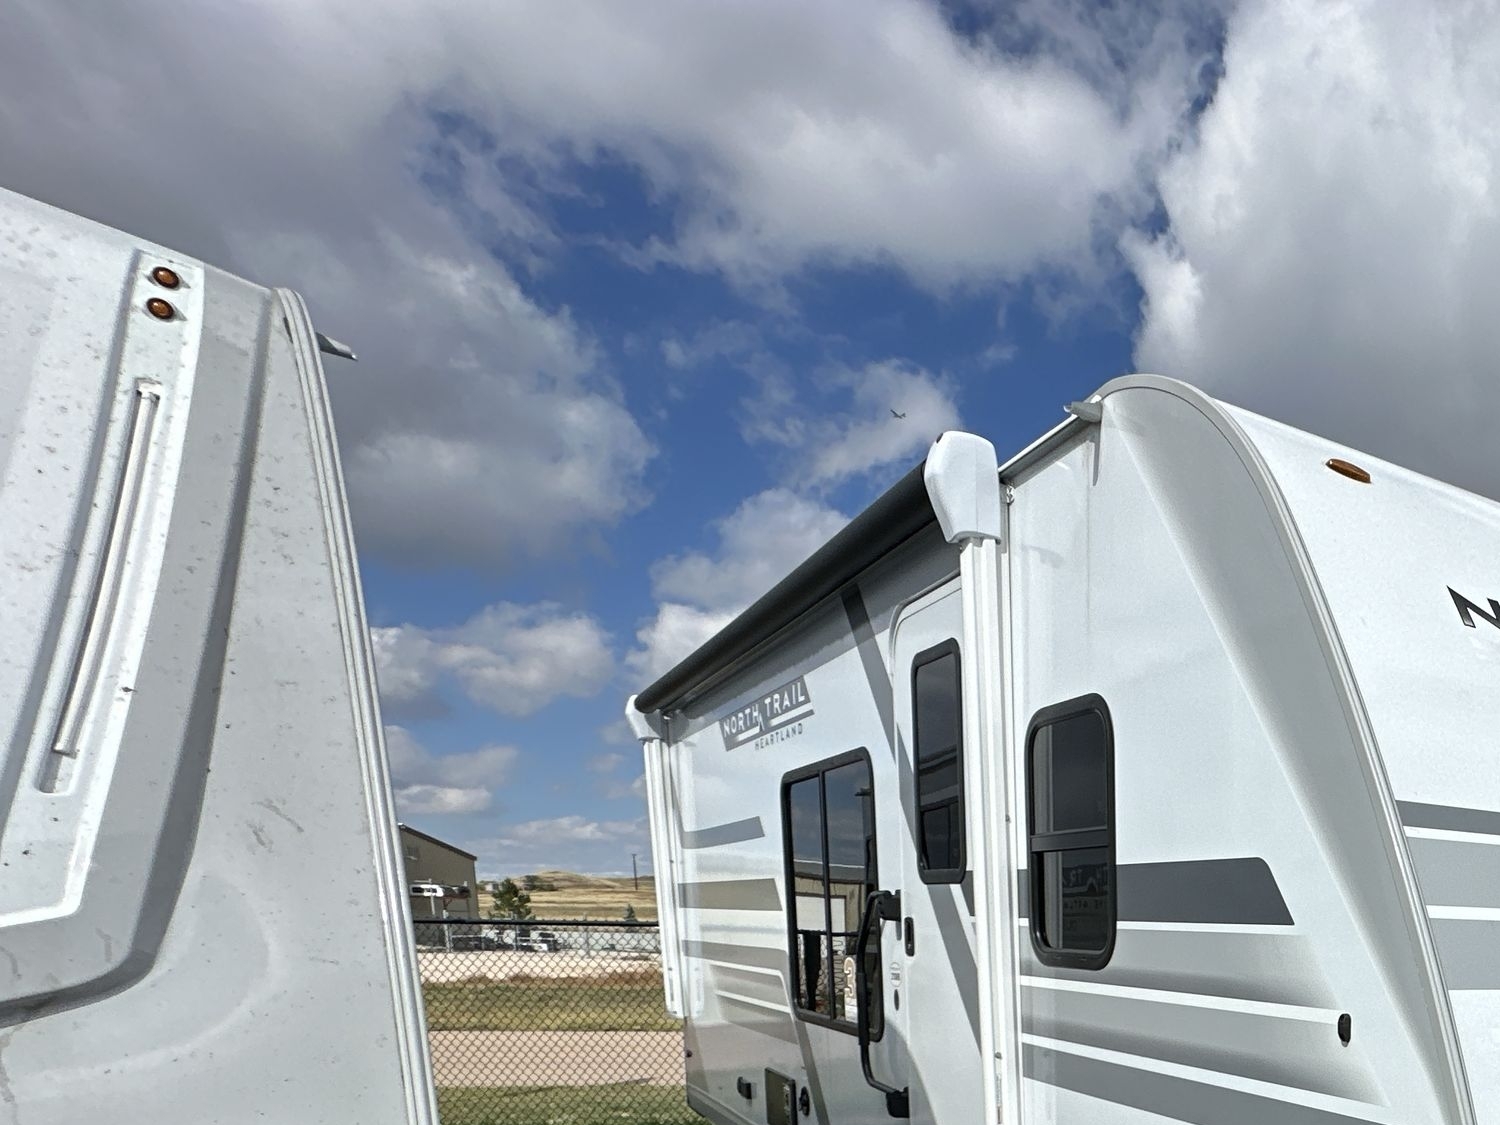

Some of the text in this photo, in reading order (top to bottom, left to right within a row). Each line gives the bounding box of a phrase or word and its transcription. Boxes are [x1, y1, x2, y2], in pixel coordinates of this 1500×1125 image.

[723, 682, 805, 738] NORTH TRAIL
[754, 722, 803, 750] HEARTLAND
